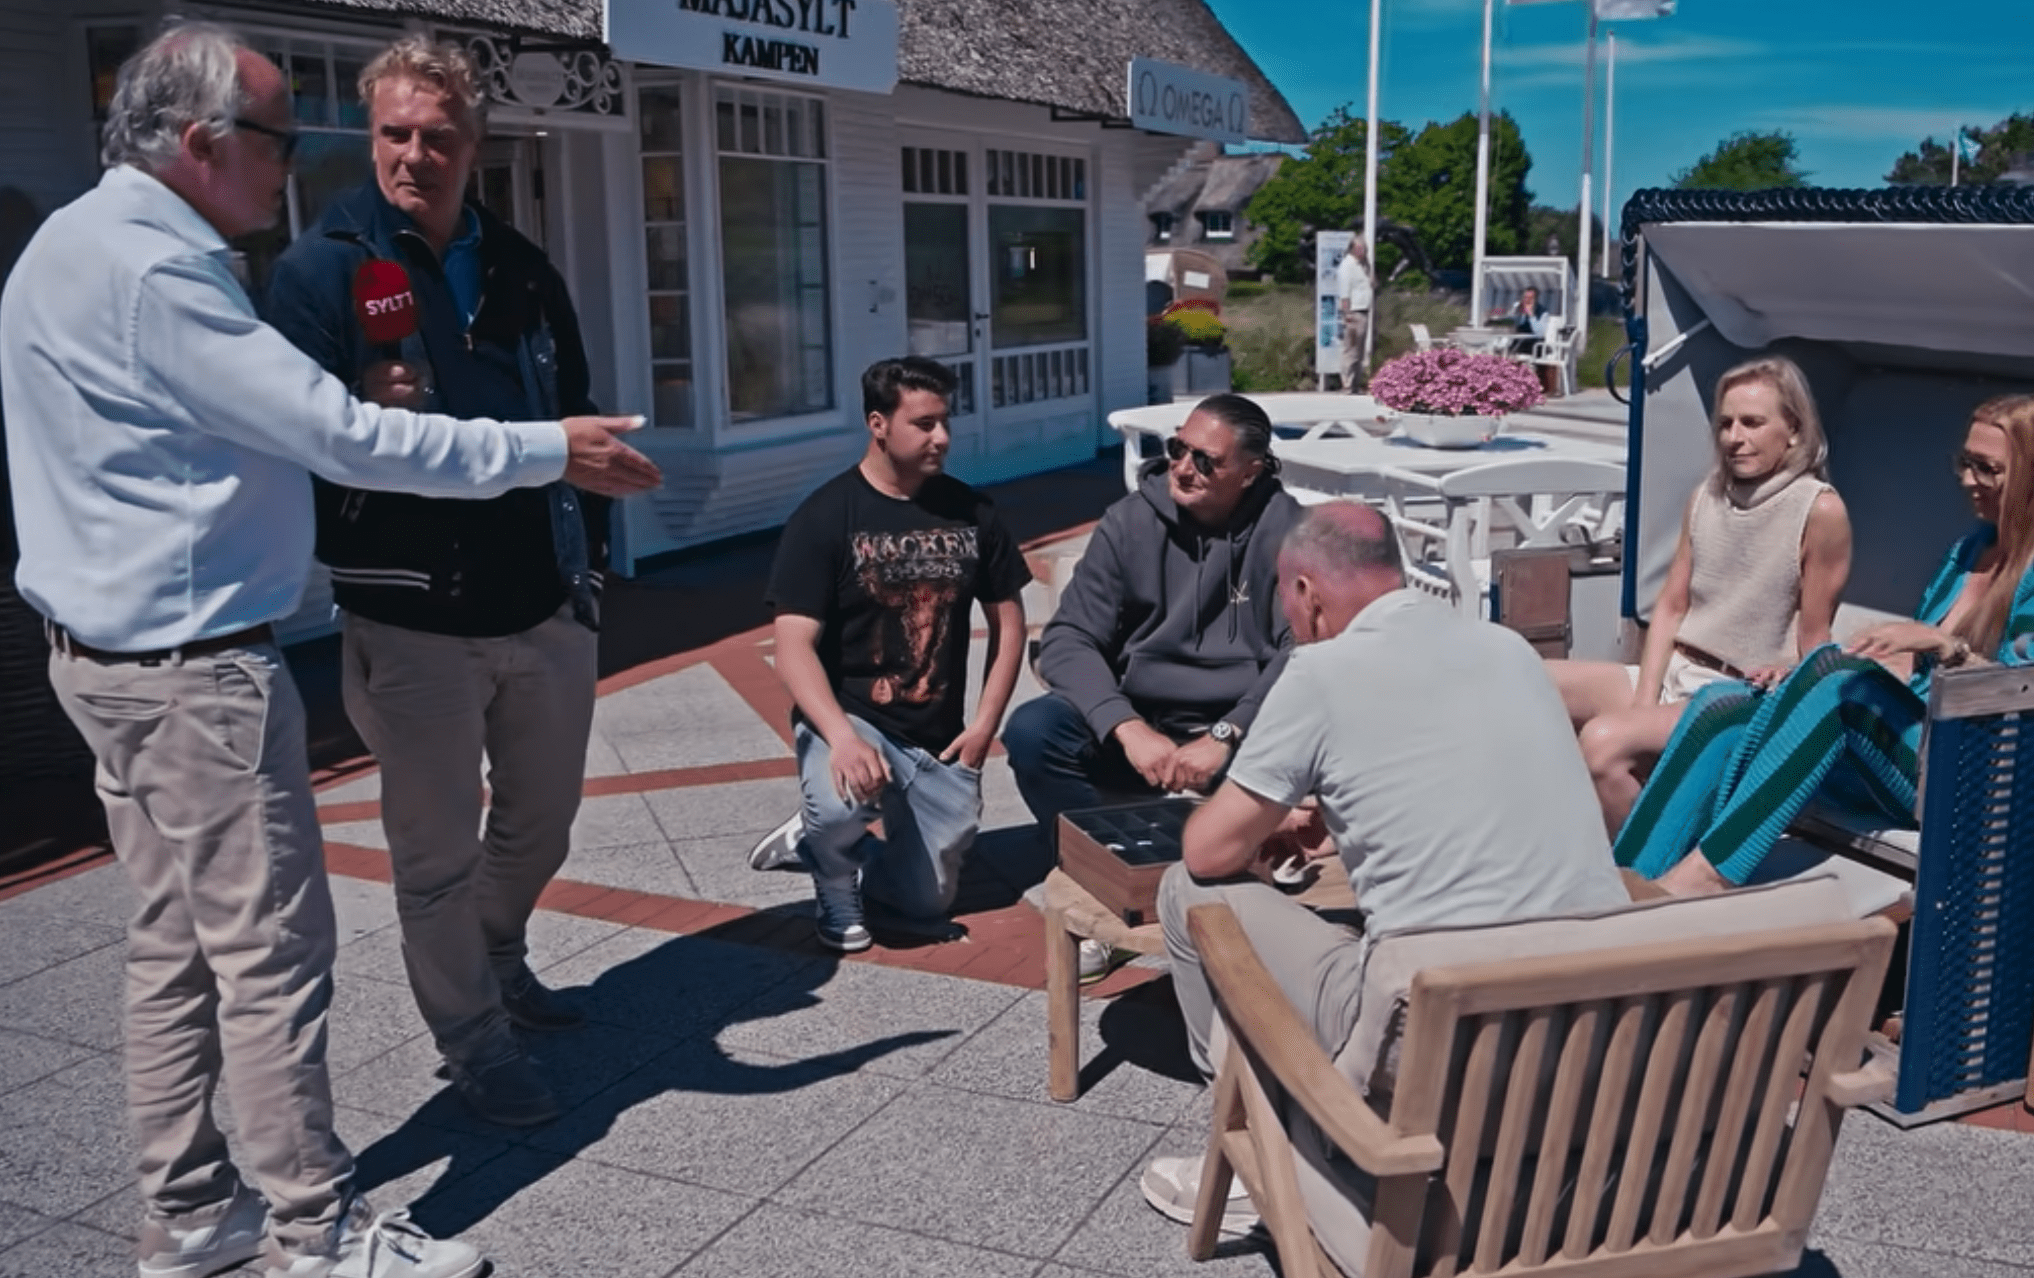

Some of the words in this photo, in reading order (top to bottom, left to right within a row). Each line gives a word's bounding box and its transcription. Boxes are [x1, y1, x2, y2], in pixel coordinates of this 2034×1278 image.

[678, 0, 856, 38] JASYLT
[723, 32, 819, 75] KAMPEN
[1162, 84, 1224, 129] OMEGA
